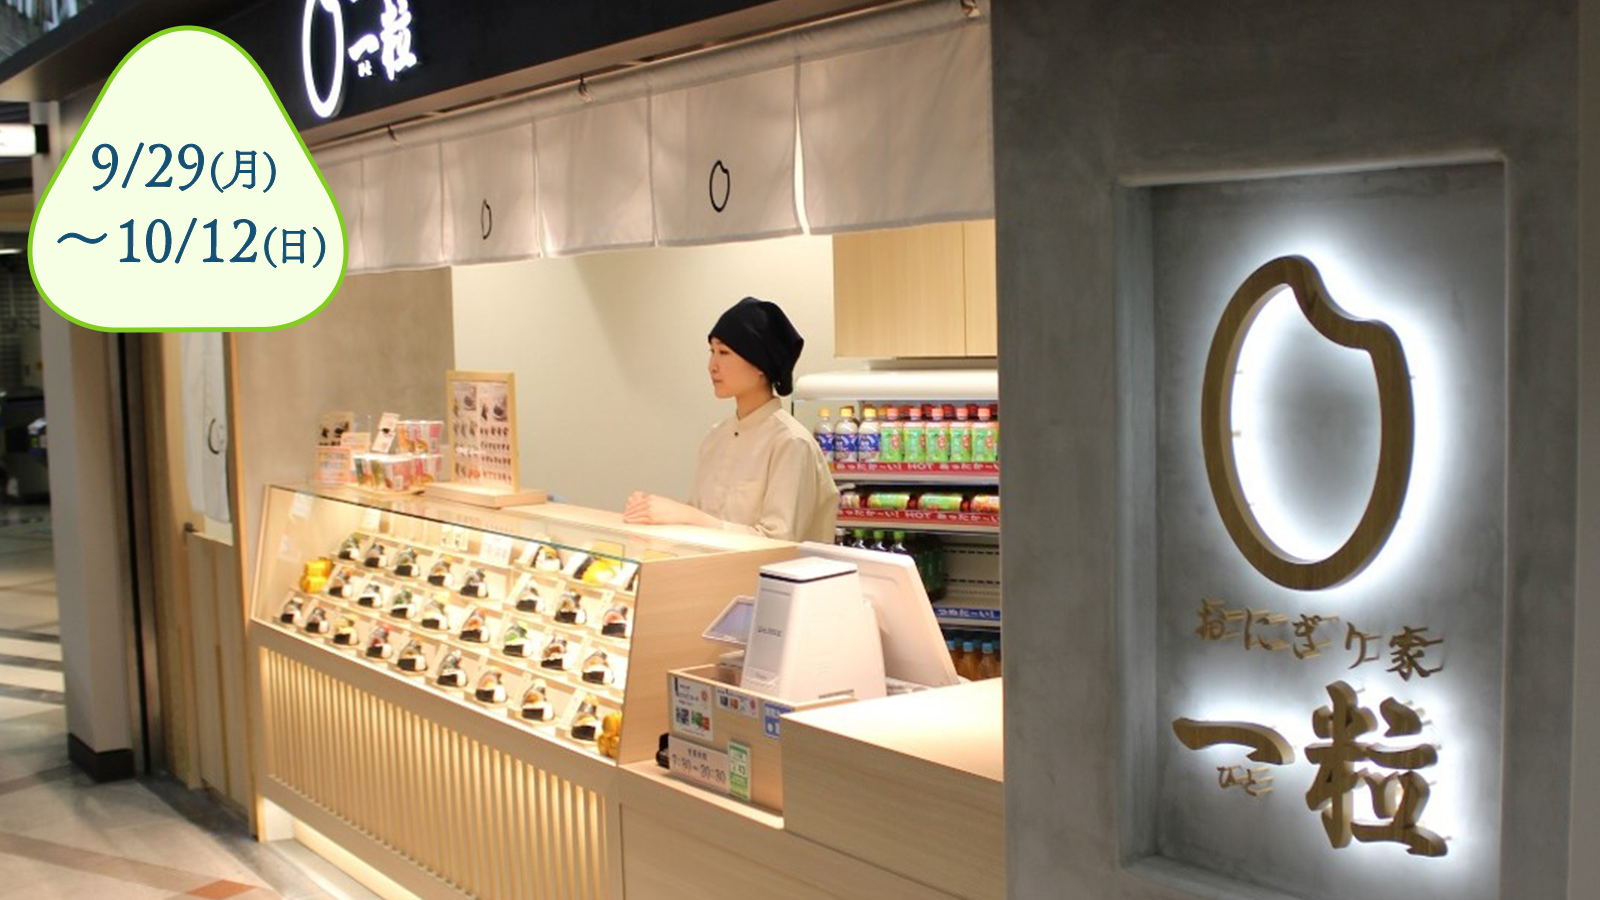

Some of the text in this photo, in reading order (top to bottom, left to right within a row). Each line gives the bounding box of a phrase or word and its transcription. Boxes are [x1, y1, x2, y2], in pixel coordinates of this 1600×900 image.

[907, 463, 933, 471] HOT
[905, 509, 931, 519] HOT
[1196, 598, 1440, 682] おにぎり家
[1172, 680, 1448, 858] 一粒
[1216, 765, 1270, 797] ひと
